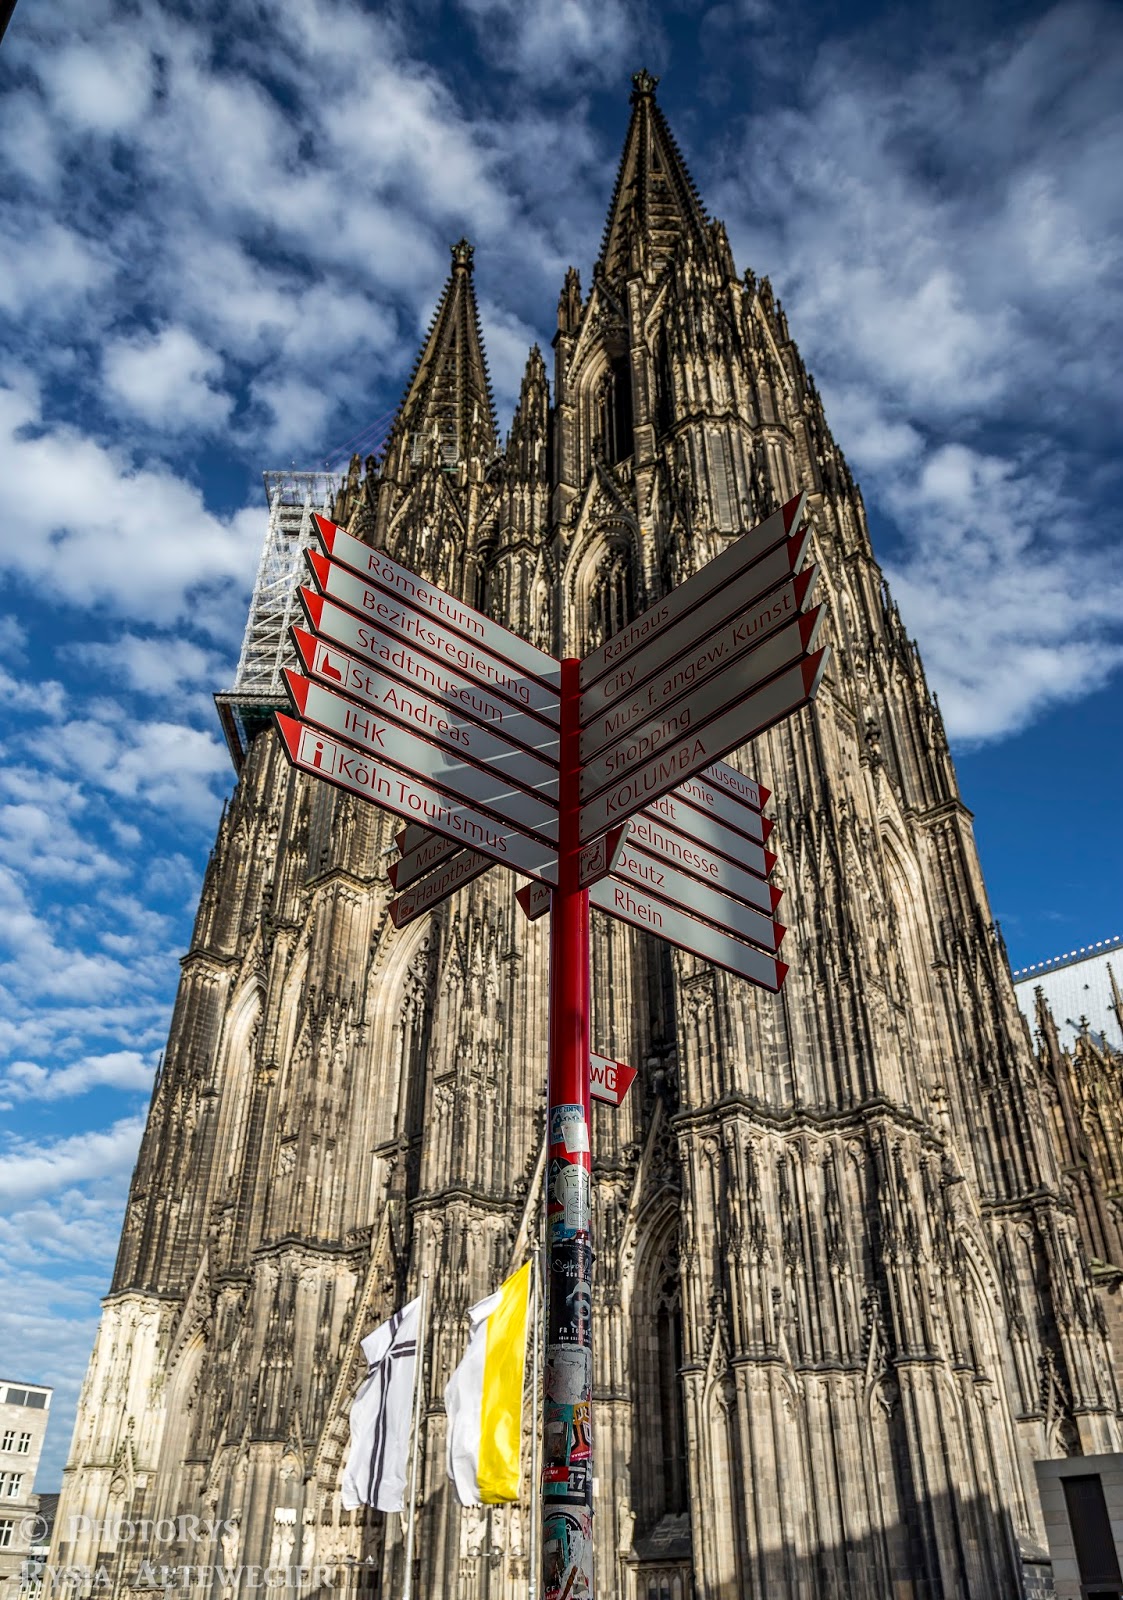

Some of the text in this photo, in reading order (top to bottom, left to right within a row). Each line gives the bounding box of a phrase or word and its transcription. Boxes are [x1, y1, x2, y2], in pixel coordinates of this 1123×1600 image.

[367, 554, 486, 637] Römerturm
[362, 590, 531, 704] Bezirksregierung
[603, 605, 669, 664] Rathaus
[356, 628, 503, 723] Stadtmuseum
[603, 665, 637, 698] City
[604, 593, 792, 736] Mus. f. angew. Kunst
[343, 710, 388, 748] IHK
[350, 668, 471, 747] St. Andreas
[605, 707, 691, 776] Shopping
[606, 739, 707, 816] KOLUMBA
[680, 780, 715, 806] onie
[650, 798, 676, 820] adt
[627, 819, 720, 879] oelnmesse
[416, 852, 484, 906] Hauptbah
[532, 886, 551, 903] TAX
[614, 888, 663, 928] Rhein
